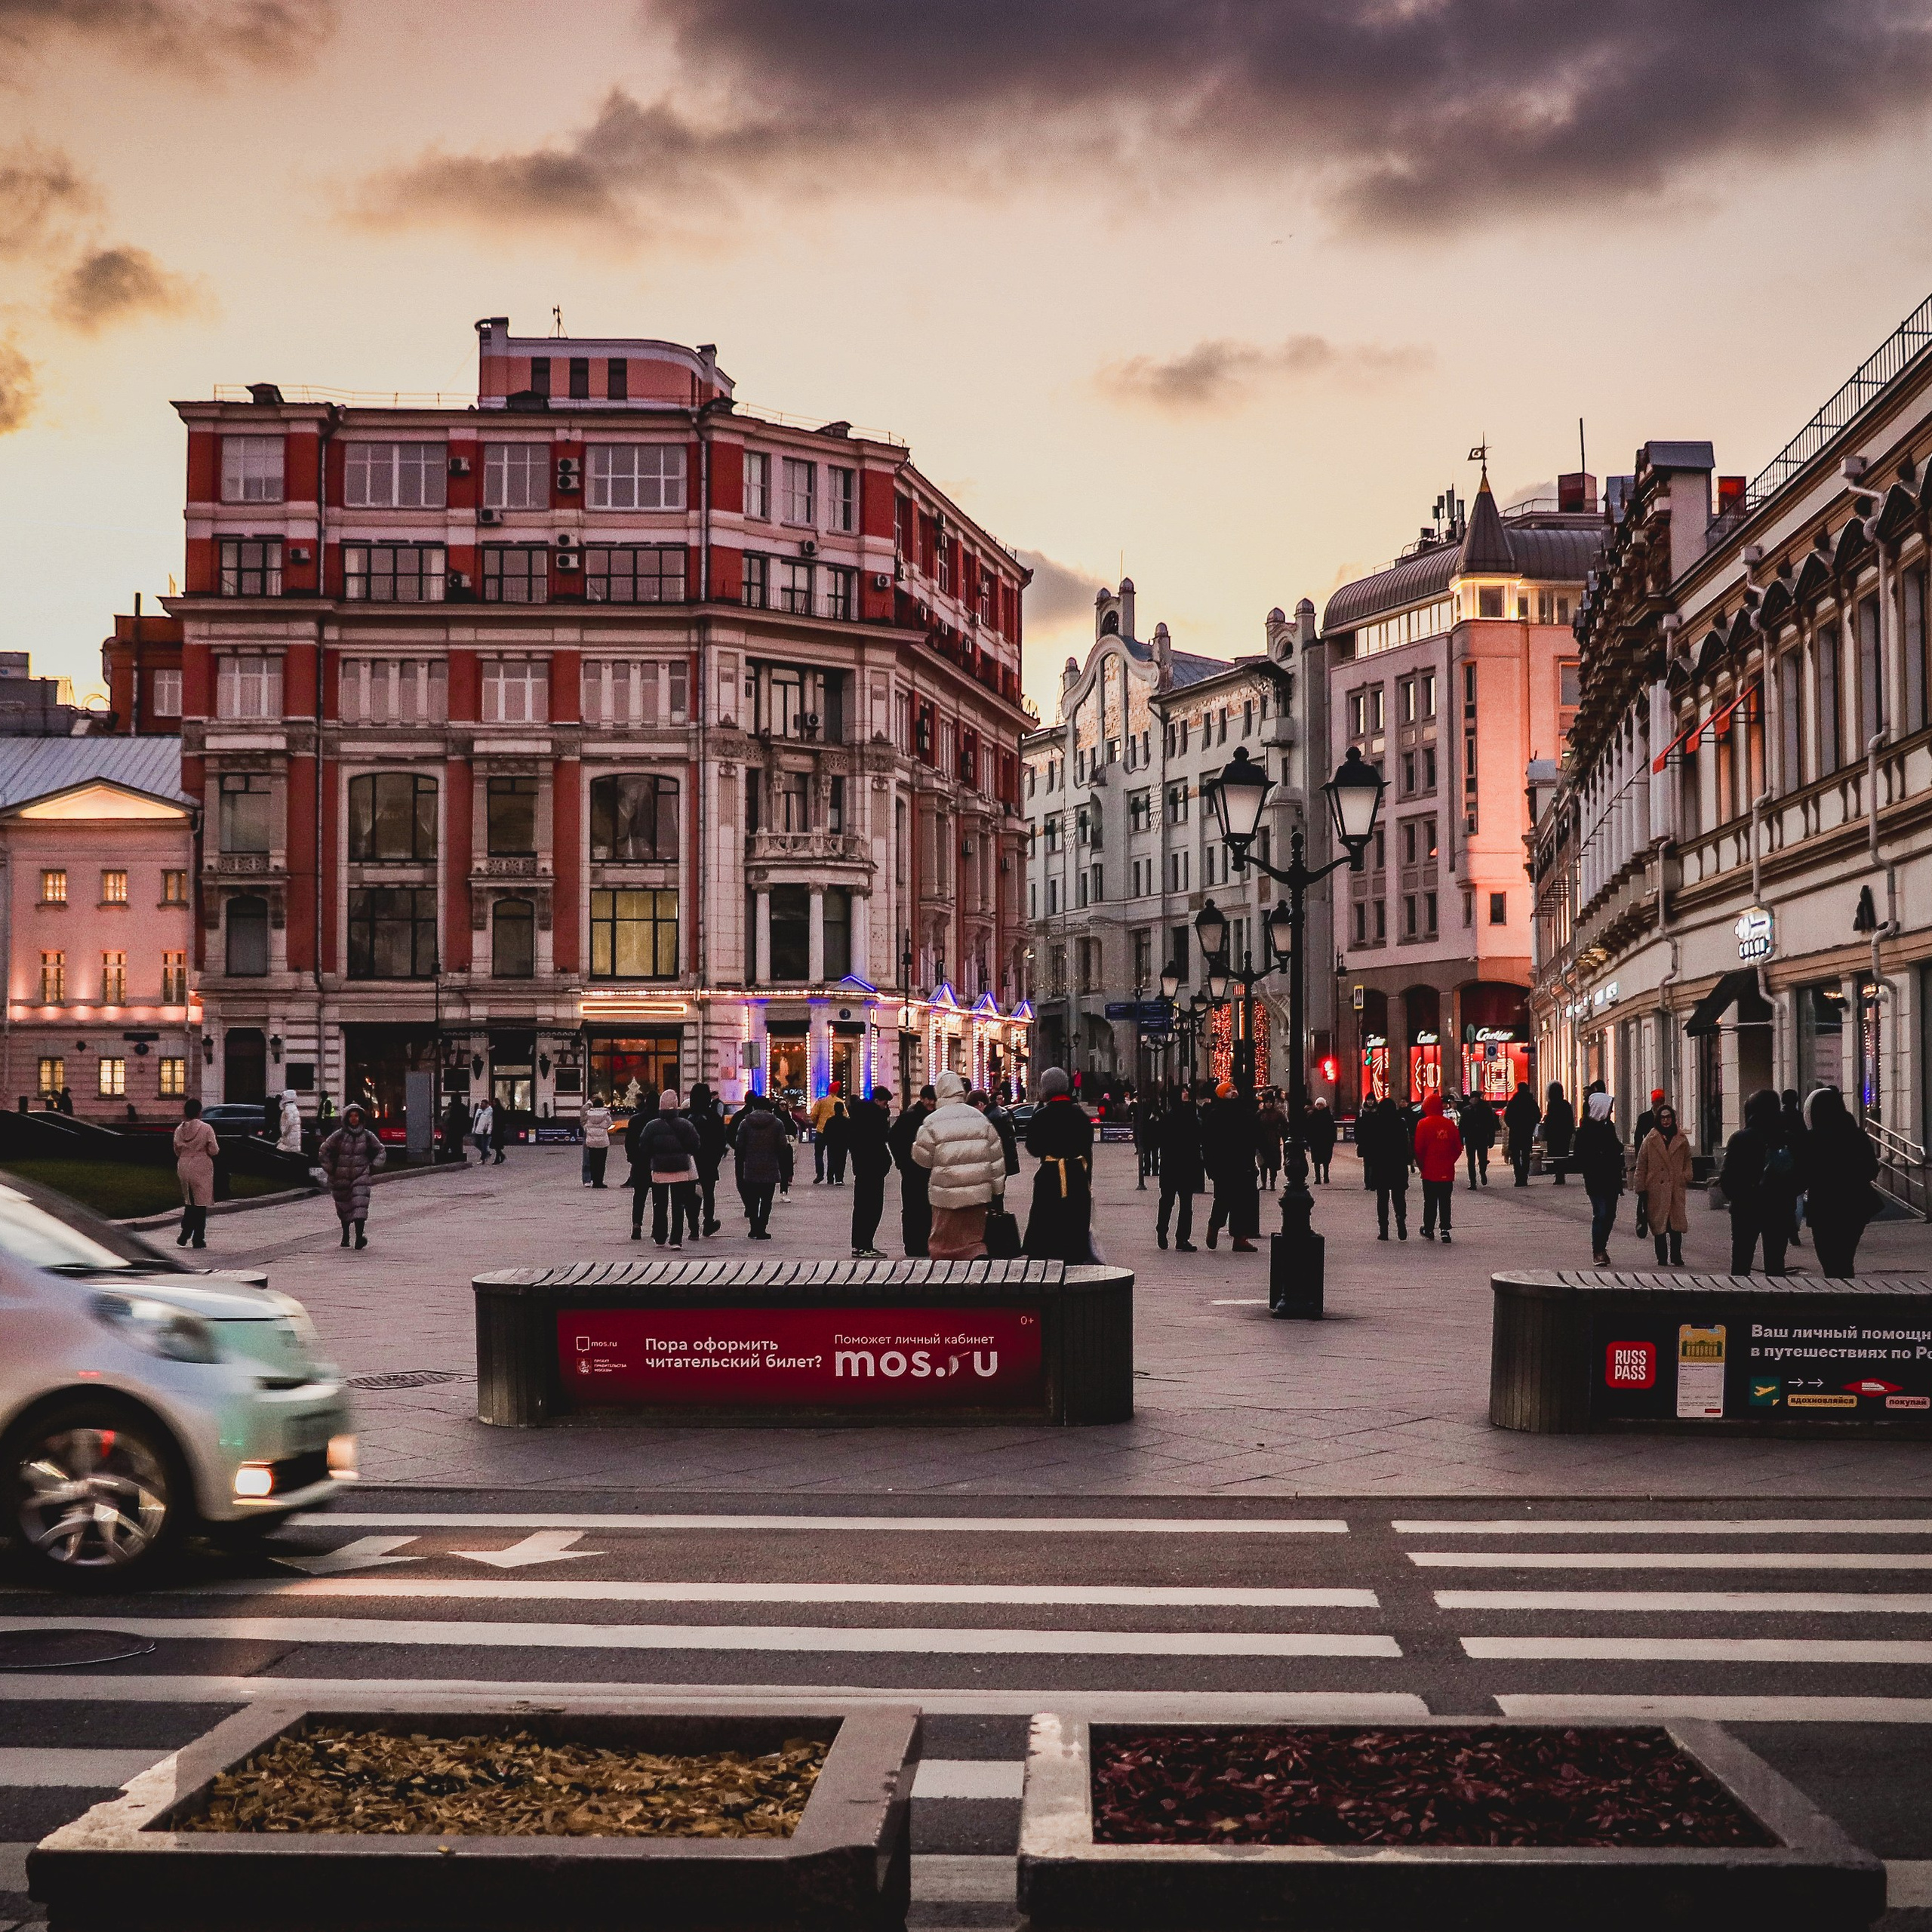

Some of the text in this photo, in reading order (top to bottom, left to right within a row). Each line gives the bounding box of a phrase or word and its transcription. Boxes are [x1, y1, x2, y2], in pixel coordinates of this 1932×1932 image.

[1476, 1027, 1514, 1041] Cartier
[1020, 1316, 1034, 1325] 0+
[1752, 1324, 1789, 1338] Ваш
[1792, 1326, 1857, 1339] личный
[645, 1337, 779, 1354] Пора оформить
[835, 1334, 995, 1344] Поможет личный кабинет
[645, 1353, 823, 1367] читательский билет?
[1615, 1349, 1647, 1364] RUSS
[1750, 1347, 1760, 1356] в
[1764, 1347, 1887, 1361] путешествиях
[1891, 1349, 1912, 1359] по
[835, 1350, 998, 1377] mos.ru
[1614, 1364, 1646, 1380] PASS
[1791, 1397, 1854, 1405] вдохновляйся
[1889, 1398, 1927, 1407] покупай
